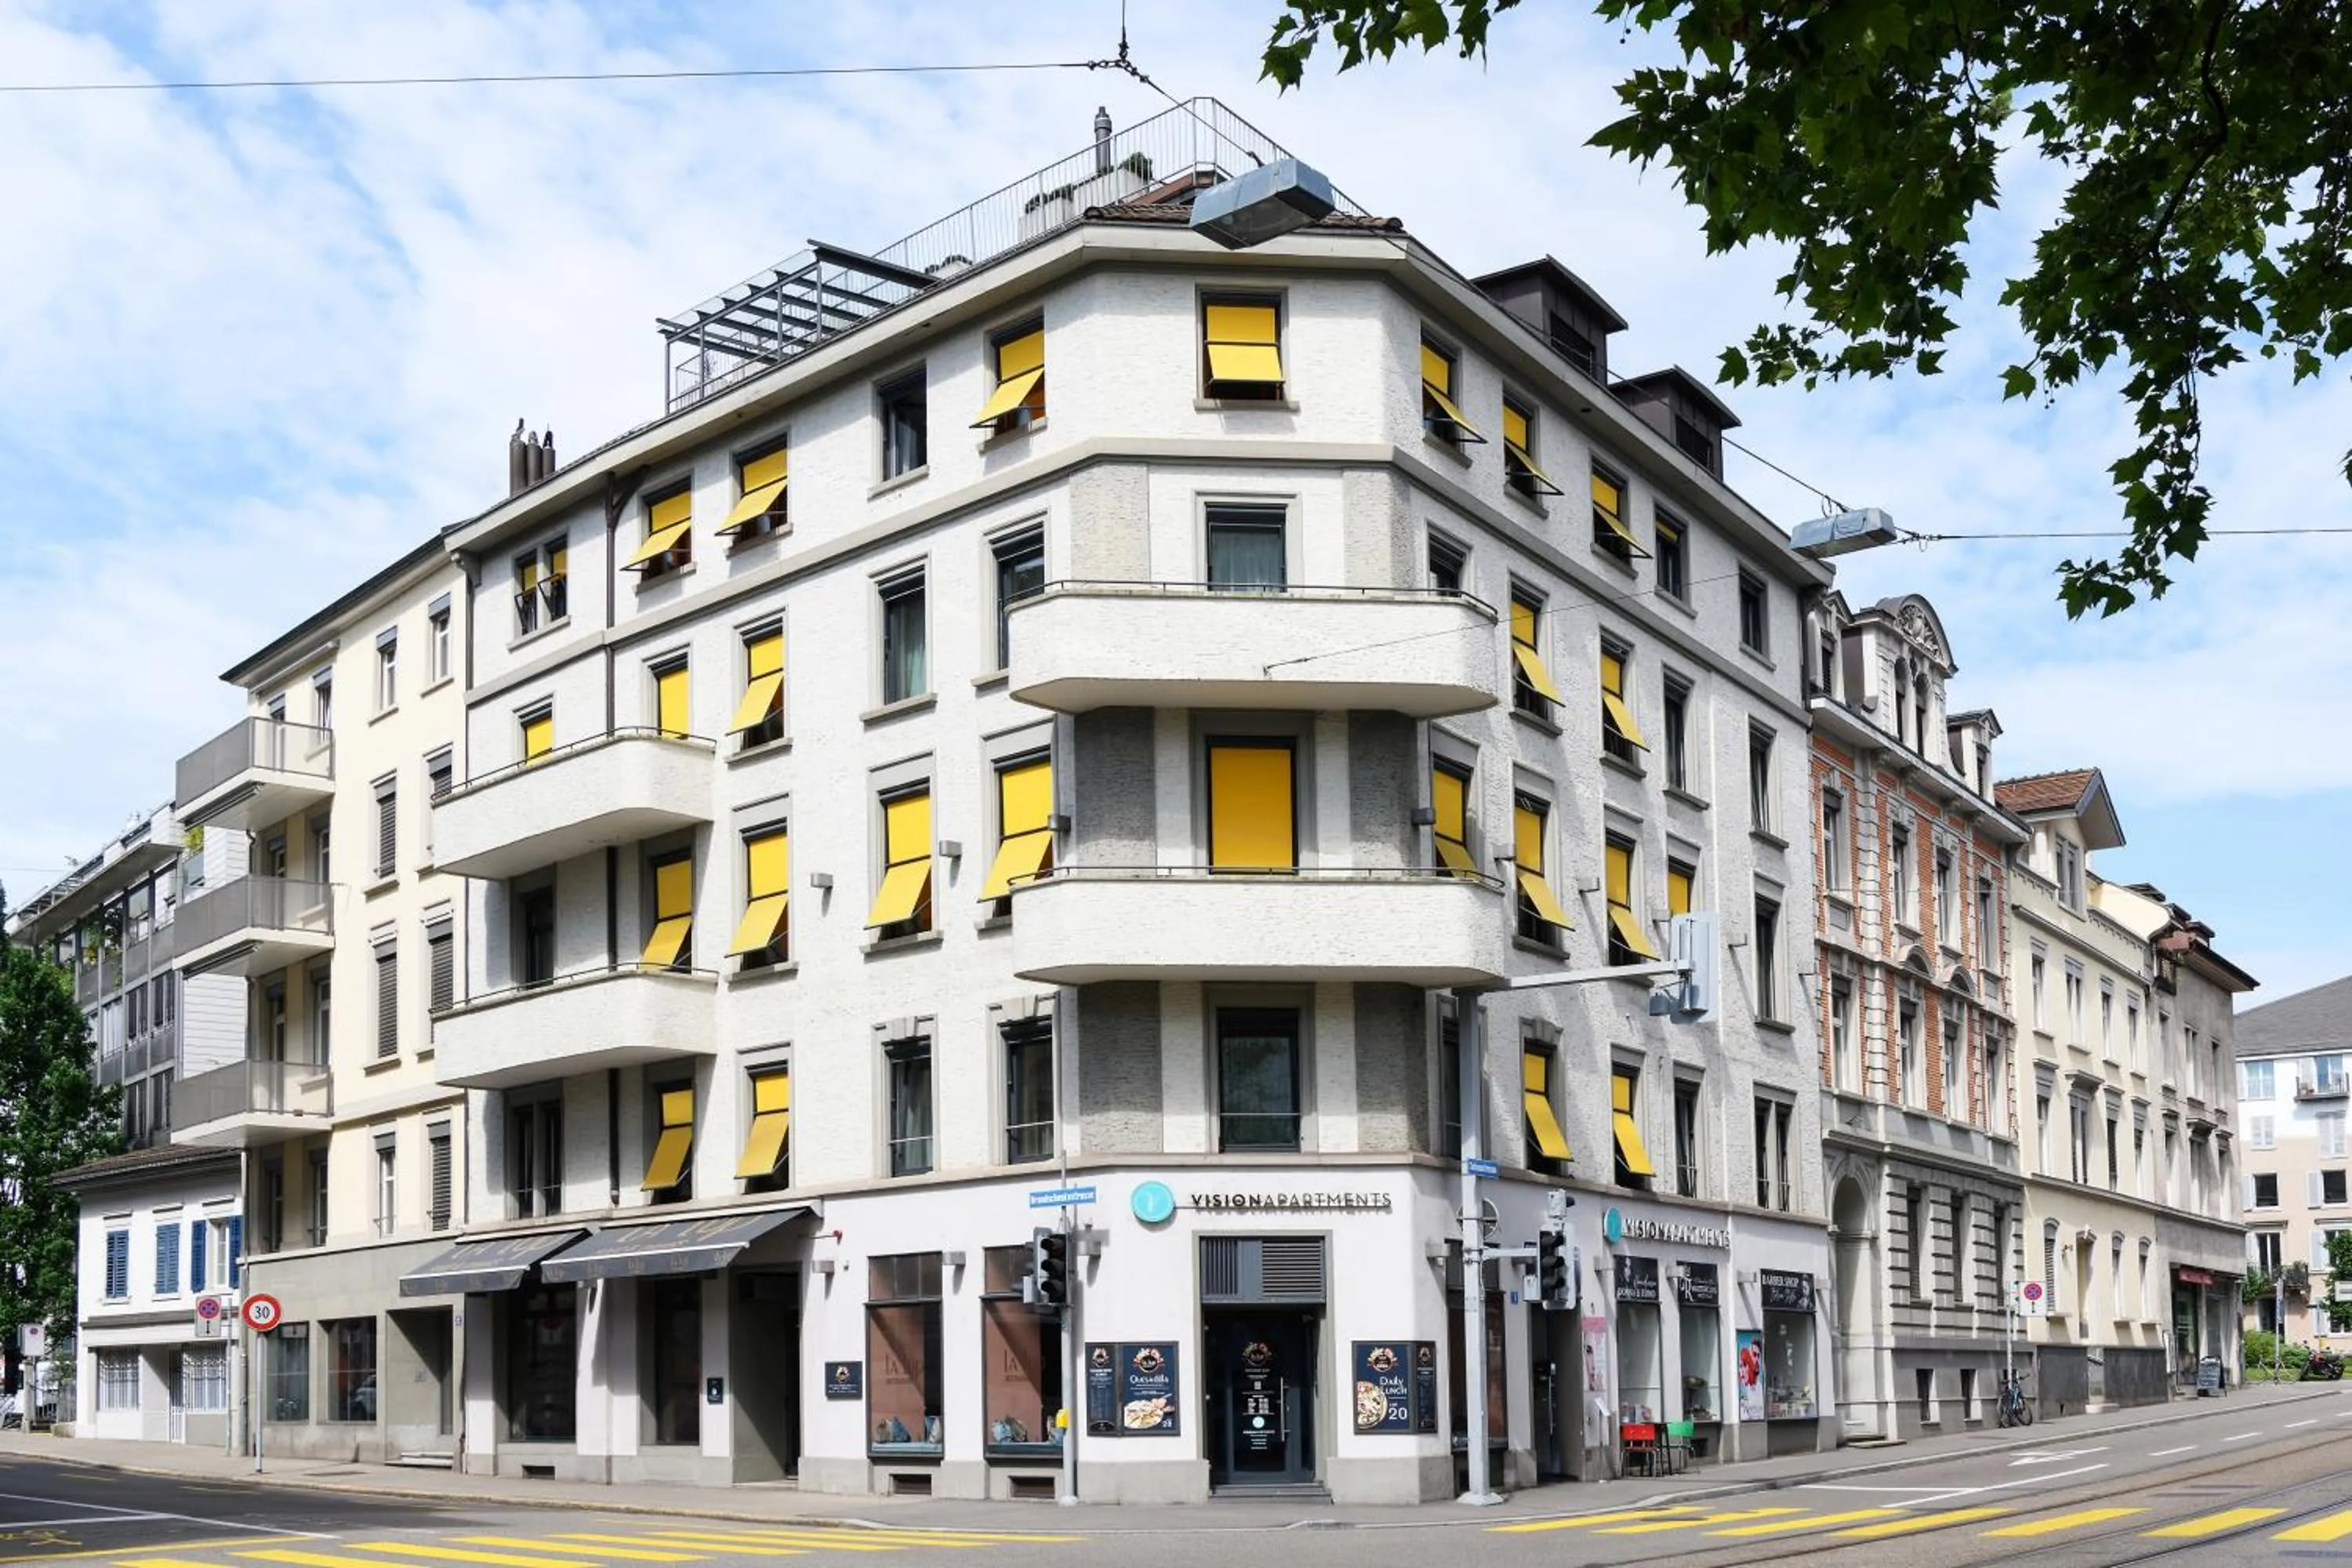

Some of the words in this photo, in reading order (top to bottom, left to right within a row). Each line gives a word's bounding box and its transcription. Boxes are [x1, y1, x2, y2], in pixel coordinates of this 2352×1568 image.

[1191, 1192, 1392, 1209] VISIONAPARTMENTS
[254, 1305, 270, 1319] 30
[1388, 1407, 1407, 1420] 20
